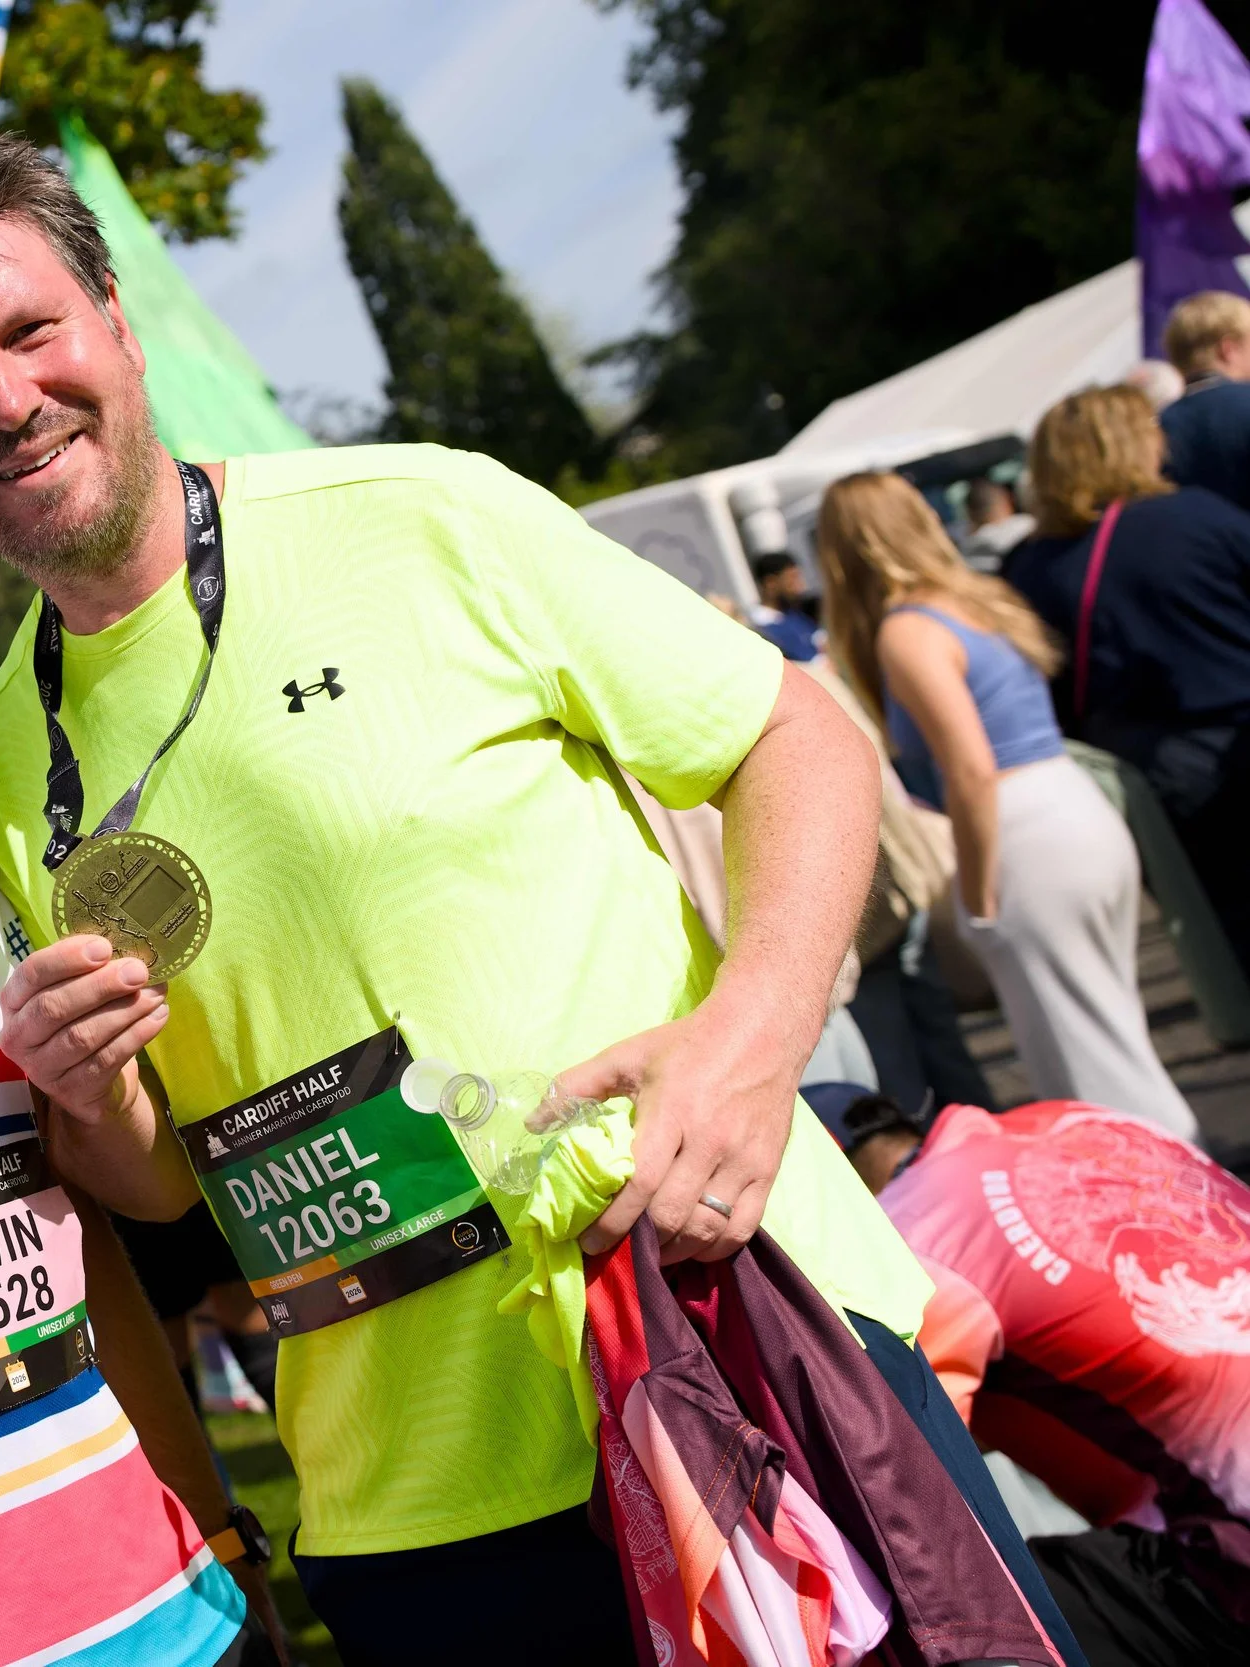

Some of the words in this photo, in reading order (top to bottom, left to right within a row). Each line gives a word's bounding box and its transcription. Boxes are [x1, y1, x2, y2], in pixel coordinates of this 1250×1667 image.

[182, 472, 203, 526] CARDIFF
[222, 1090, 290, 1136] CARDIFF
[292, 1064, 343, 1103] HALF
[232, 1129, 262, 1149] HANNER
[262, 1109, 306, 1135] MARATHON
[305, 1086, 351, 1113] CAERDYDD
[0, 1174, 30, 1192] CAERDYDD
[225, 1127, 380, 1219] DANIEL
[258, 1179, 391, 1264] 12063
[370, 1227, 408, 1251] UNISEX
[408, 1209, 446, 1234] LARGE
[981, 1169, 1072, 1286] CAERDYDD
[289, 1271, 304, 1285] PEN
[345, 1286, 362, 1299] 2026
[37, 1320, 63, 1339] UNISEX
[62, 1311, 76, 1328] LARGE
[11, 1373, 27, 1386] 2026
